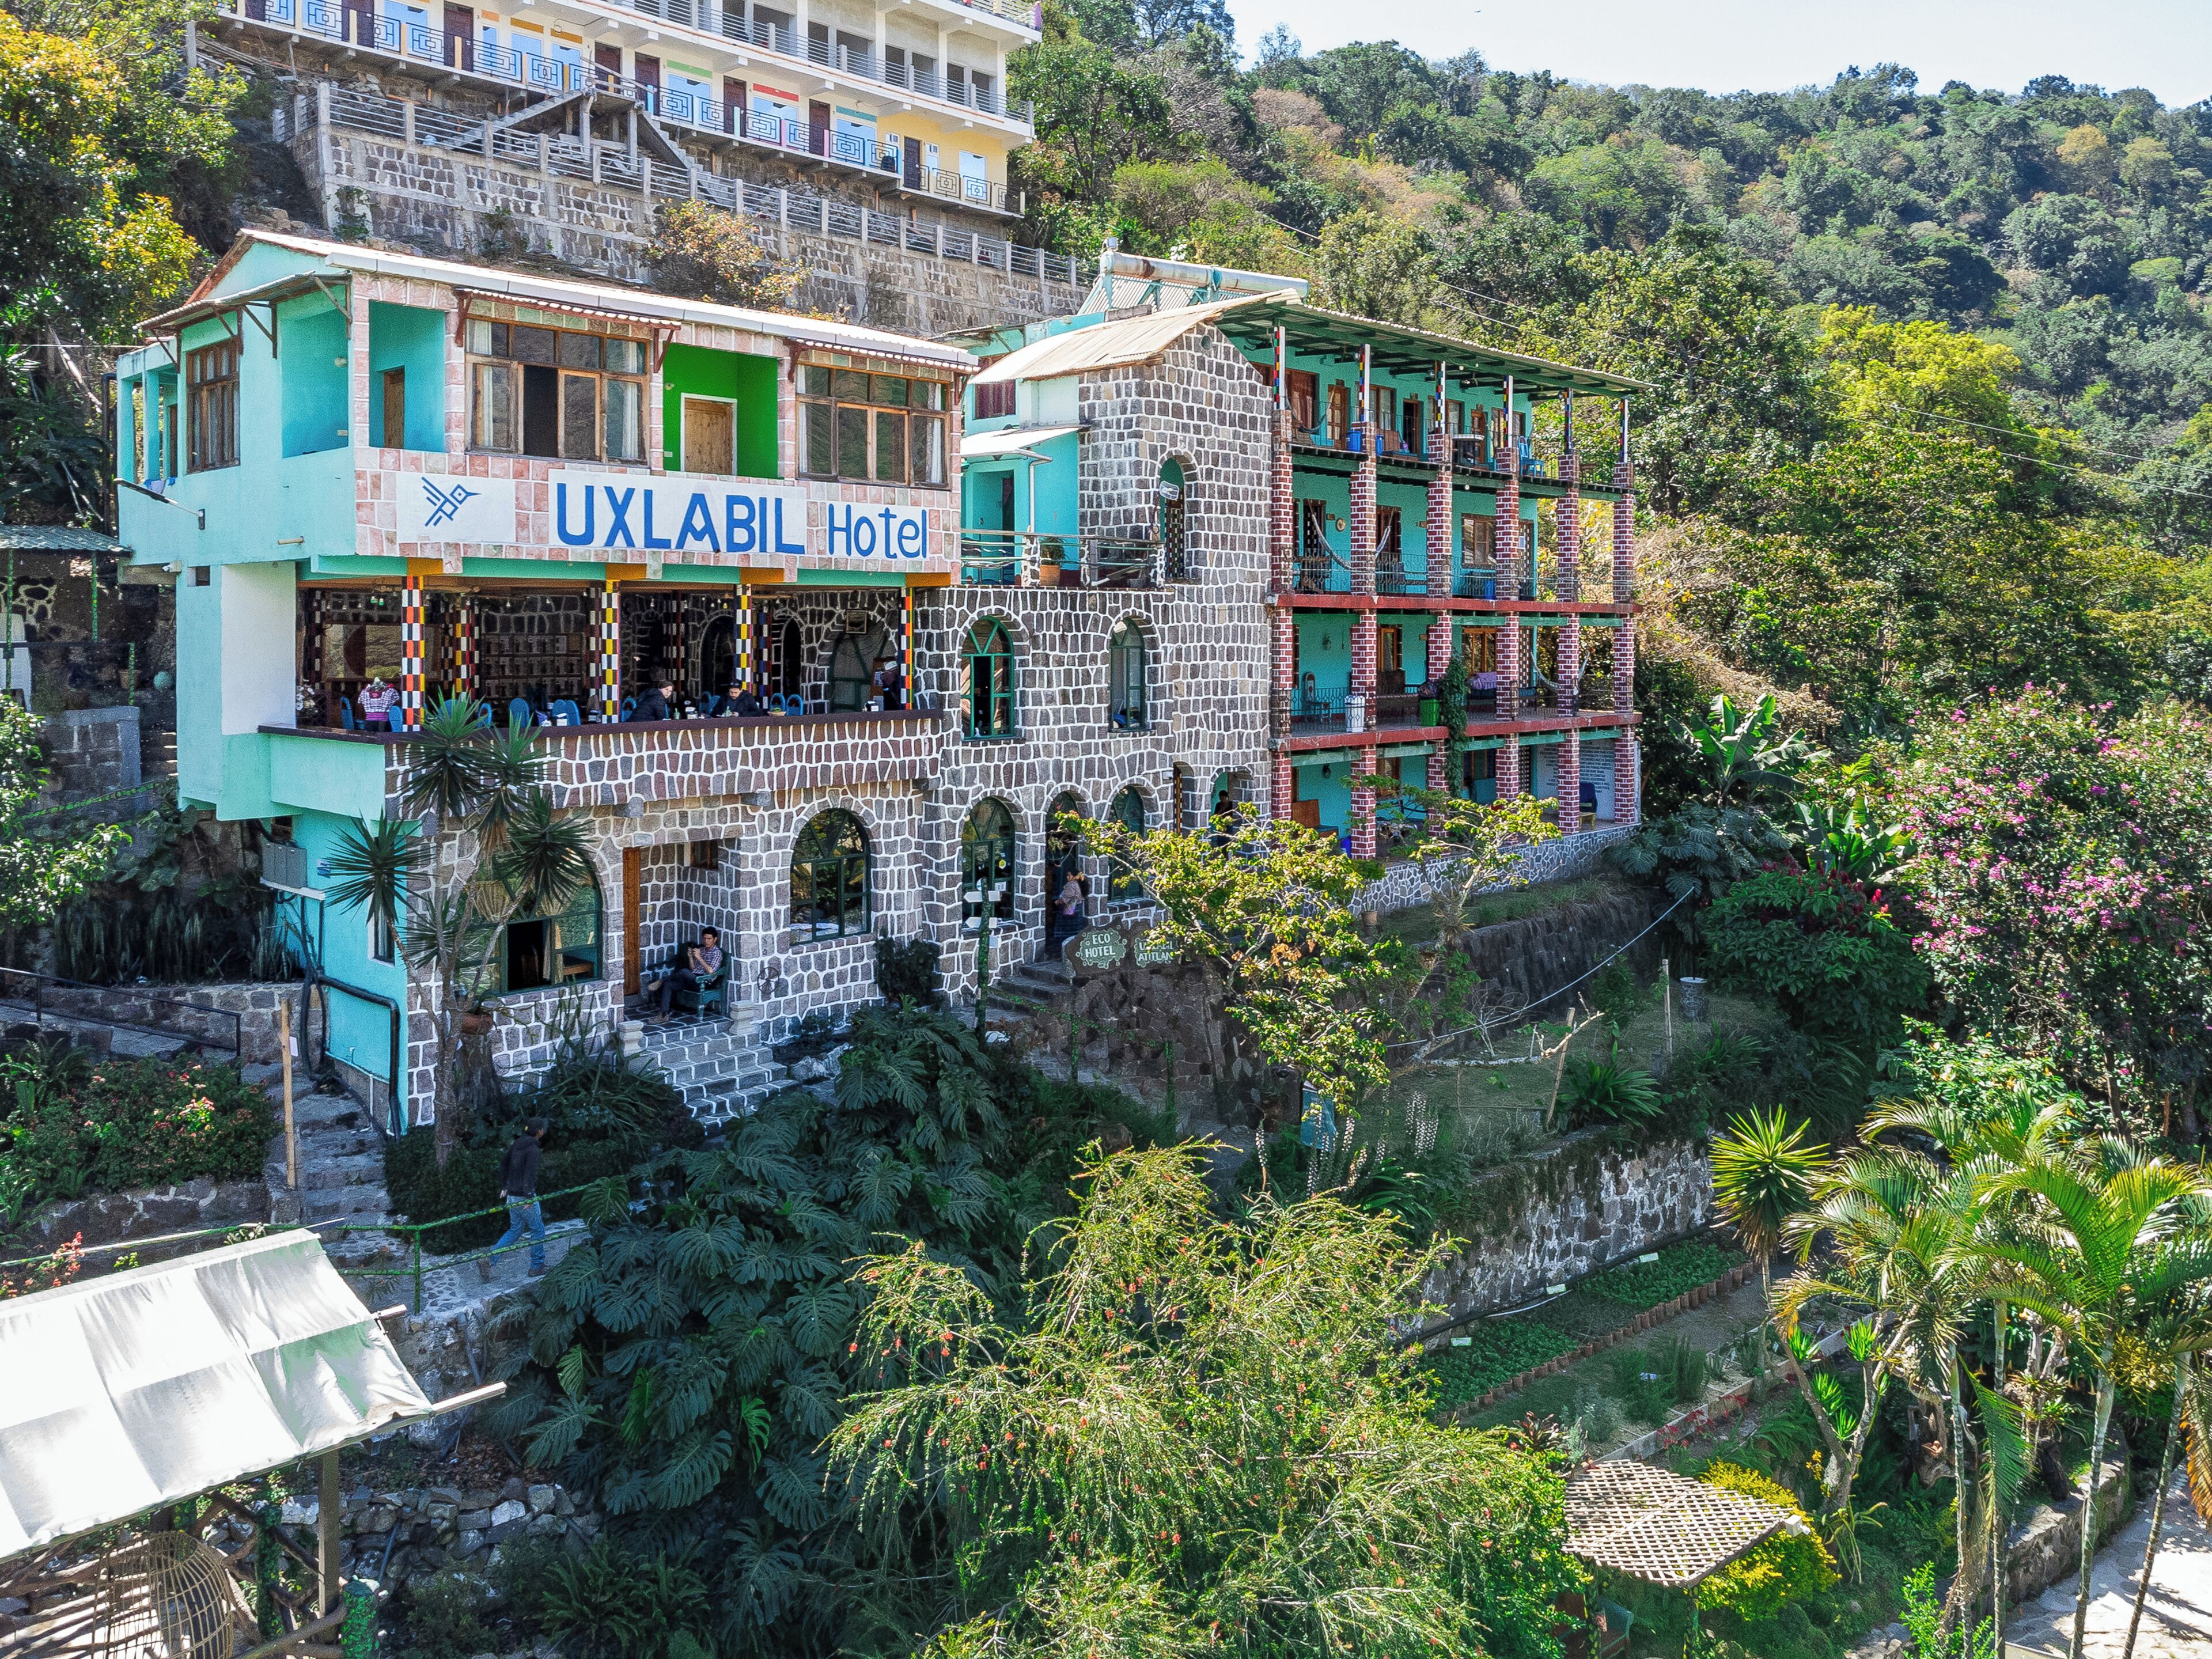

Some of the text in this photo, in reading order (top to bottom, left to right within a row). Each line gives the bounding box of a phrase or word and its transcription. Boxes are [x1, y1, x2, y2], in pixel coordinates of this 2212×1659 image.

[556, 483, 927, 559] UXLABIL Hotel
[1092, 933, 1111, 945] ECO
[1085, 946, 1116, 958] HOTEL
